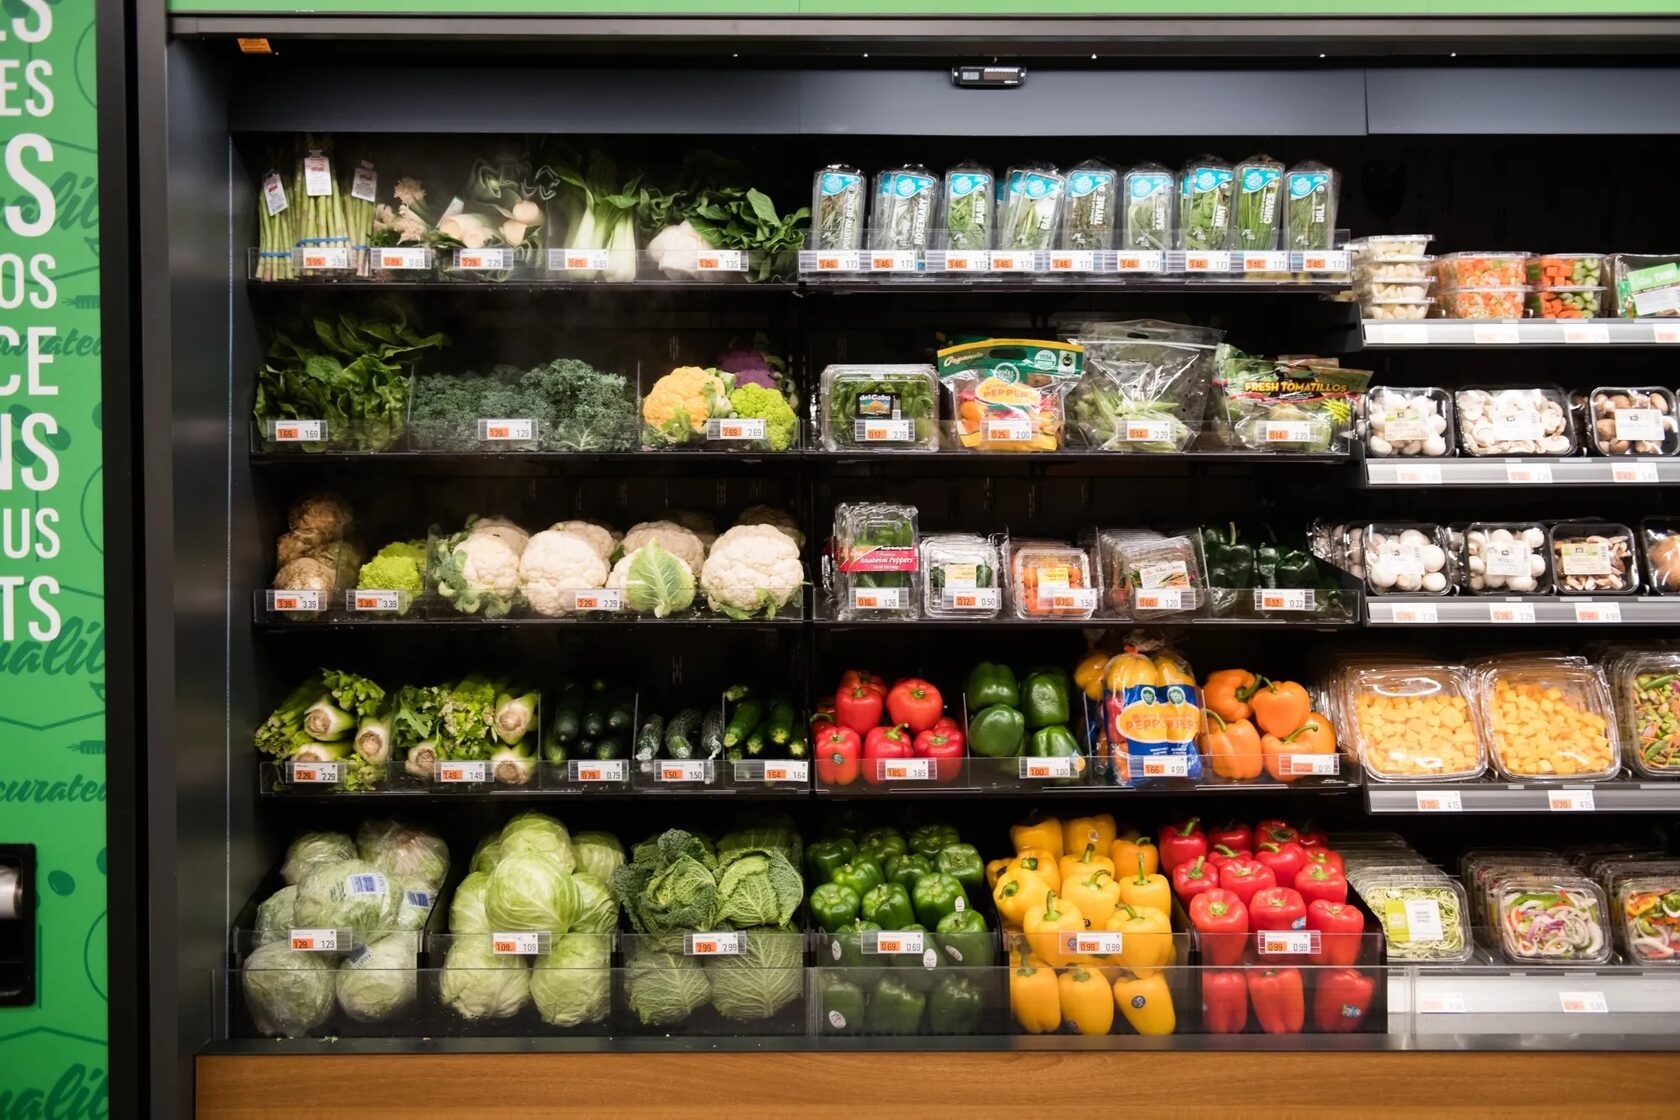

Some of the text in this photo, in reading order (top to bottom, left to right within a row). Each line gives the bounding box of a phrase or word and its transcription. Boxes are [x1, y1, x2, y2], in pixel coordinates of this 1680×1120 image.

[975, 199, 985, 224] BASIL
[1094, 195, 1106, 225] THYME
[1155, 207, 1165, 230] SAGE
[1215, 205, 1226, 227] MINT
[1263, 193, 1275, 224] CHIVES
[1315, 203, 1325, 223] DILL
[913, 198, 928, 245] ROSEMARY
[0, 253, 57, 309] OS
[1245, 381, 1347, 392] FRESH TOMATILLOS
[3, 508, 60, 559] US
[889, 557, 914, 565] Peppers
